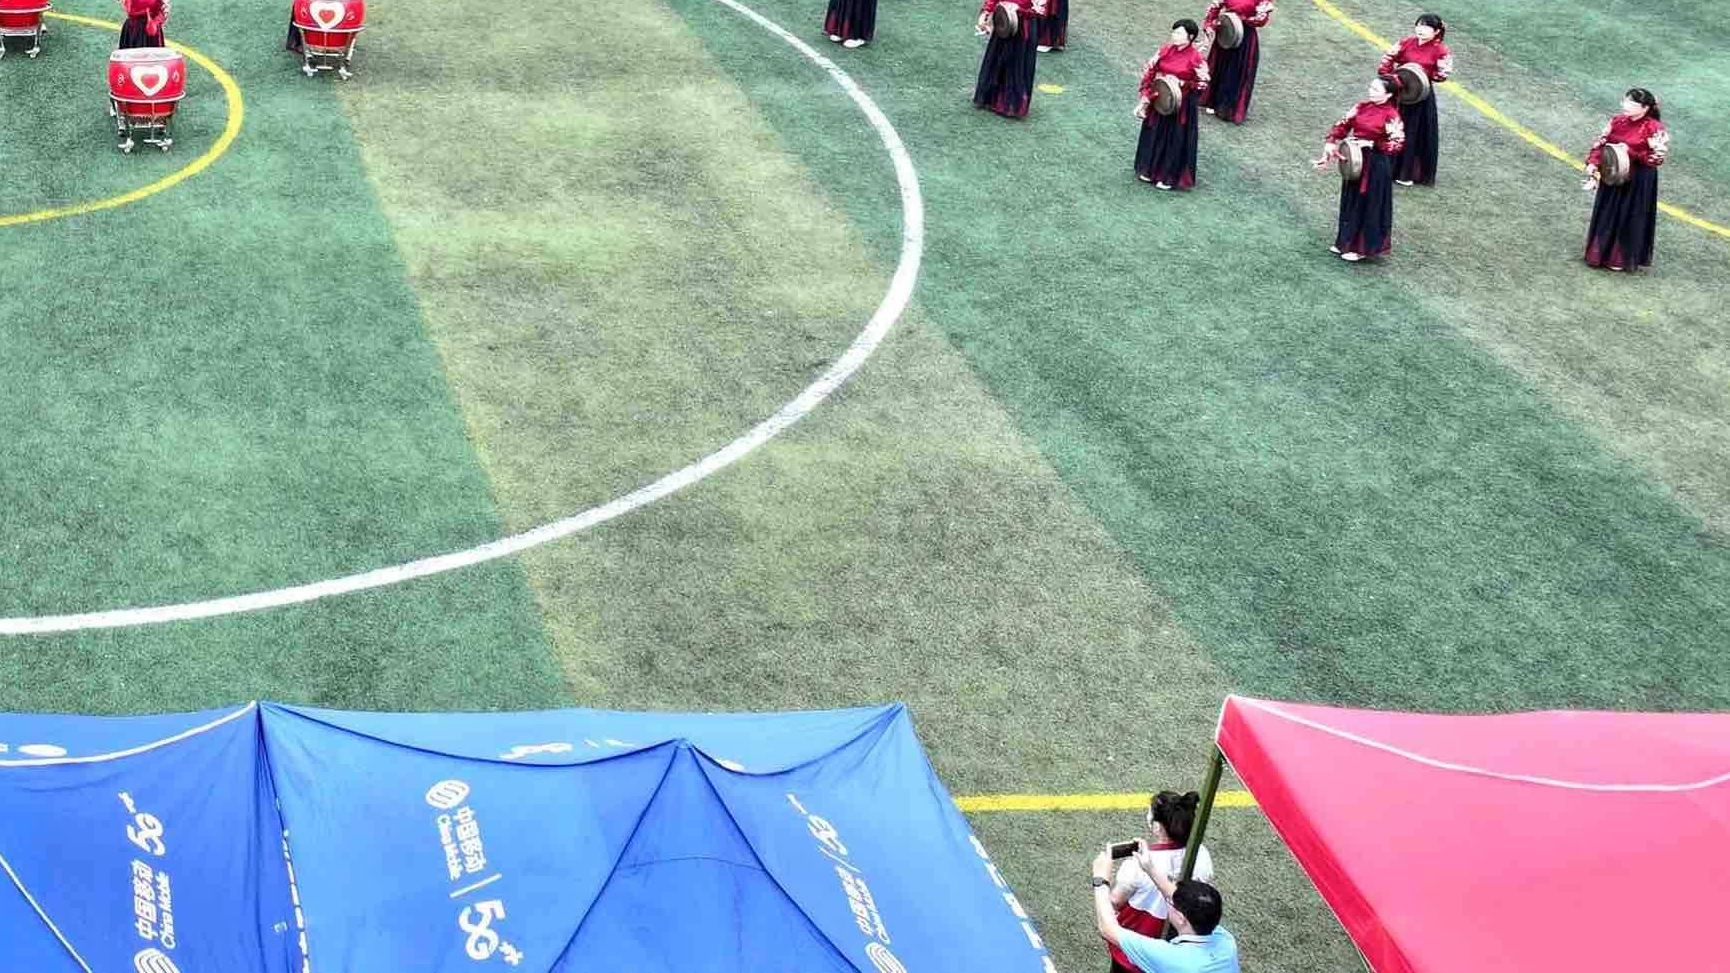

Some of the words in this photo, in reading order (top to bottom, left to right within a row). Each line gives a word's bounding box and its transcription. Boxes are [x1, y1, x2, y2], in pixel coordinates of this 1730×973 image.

[453, 805, 487, 874] 中国移动
[131, 859, 159, 941] 中国移动
[159, 910, 176, 950] China
